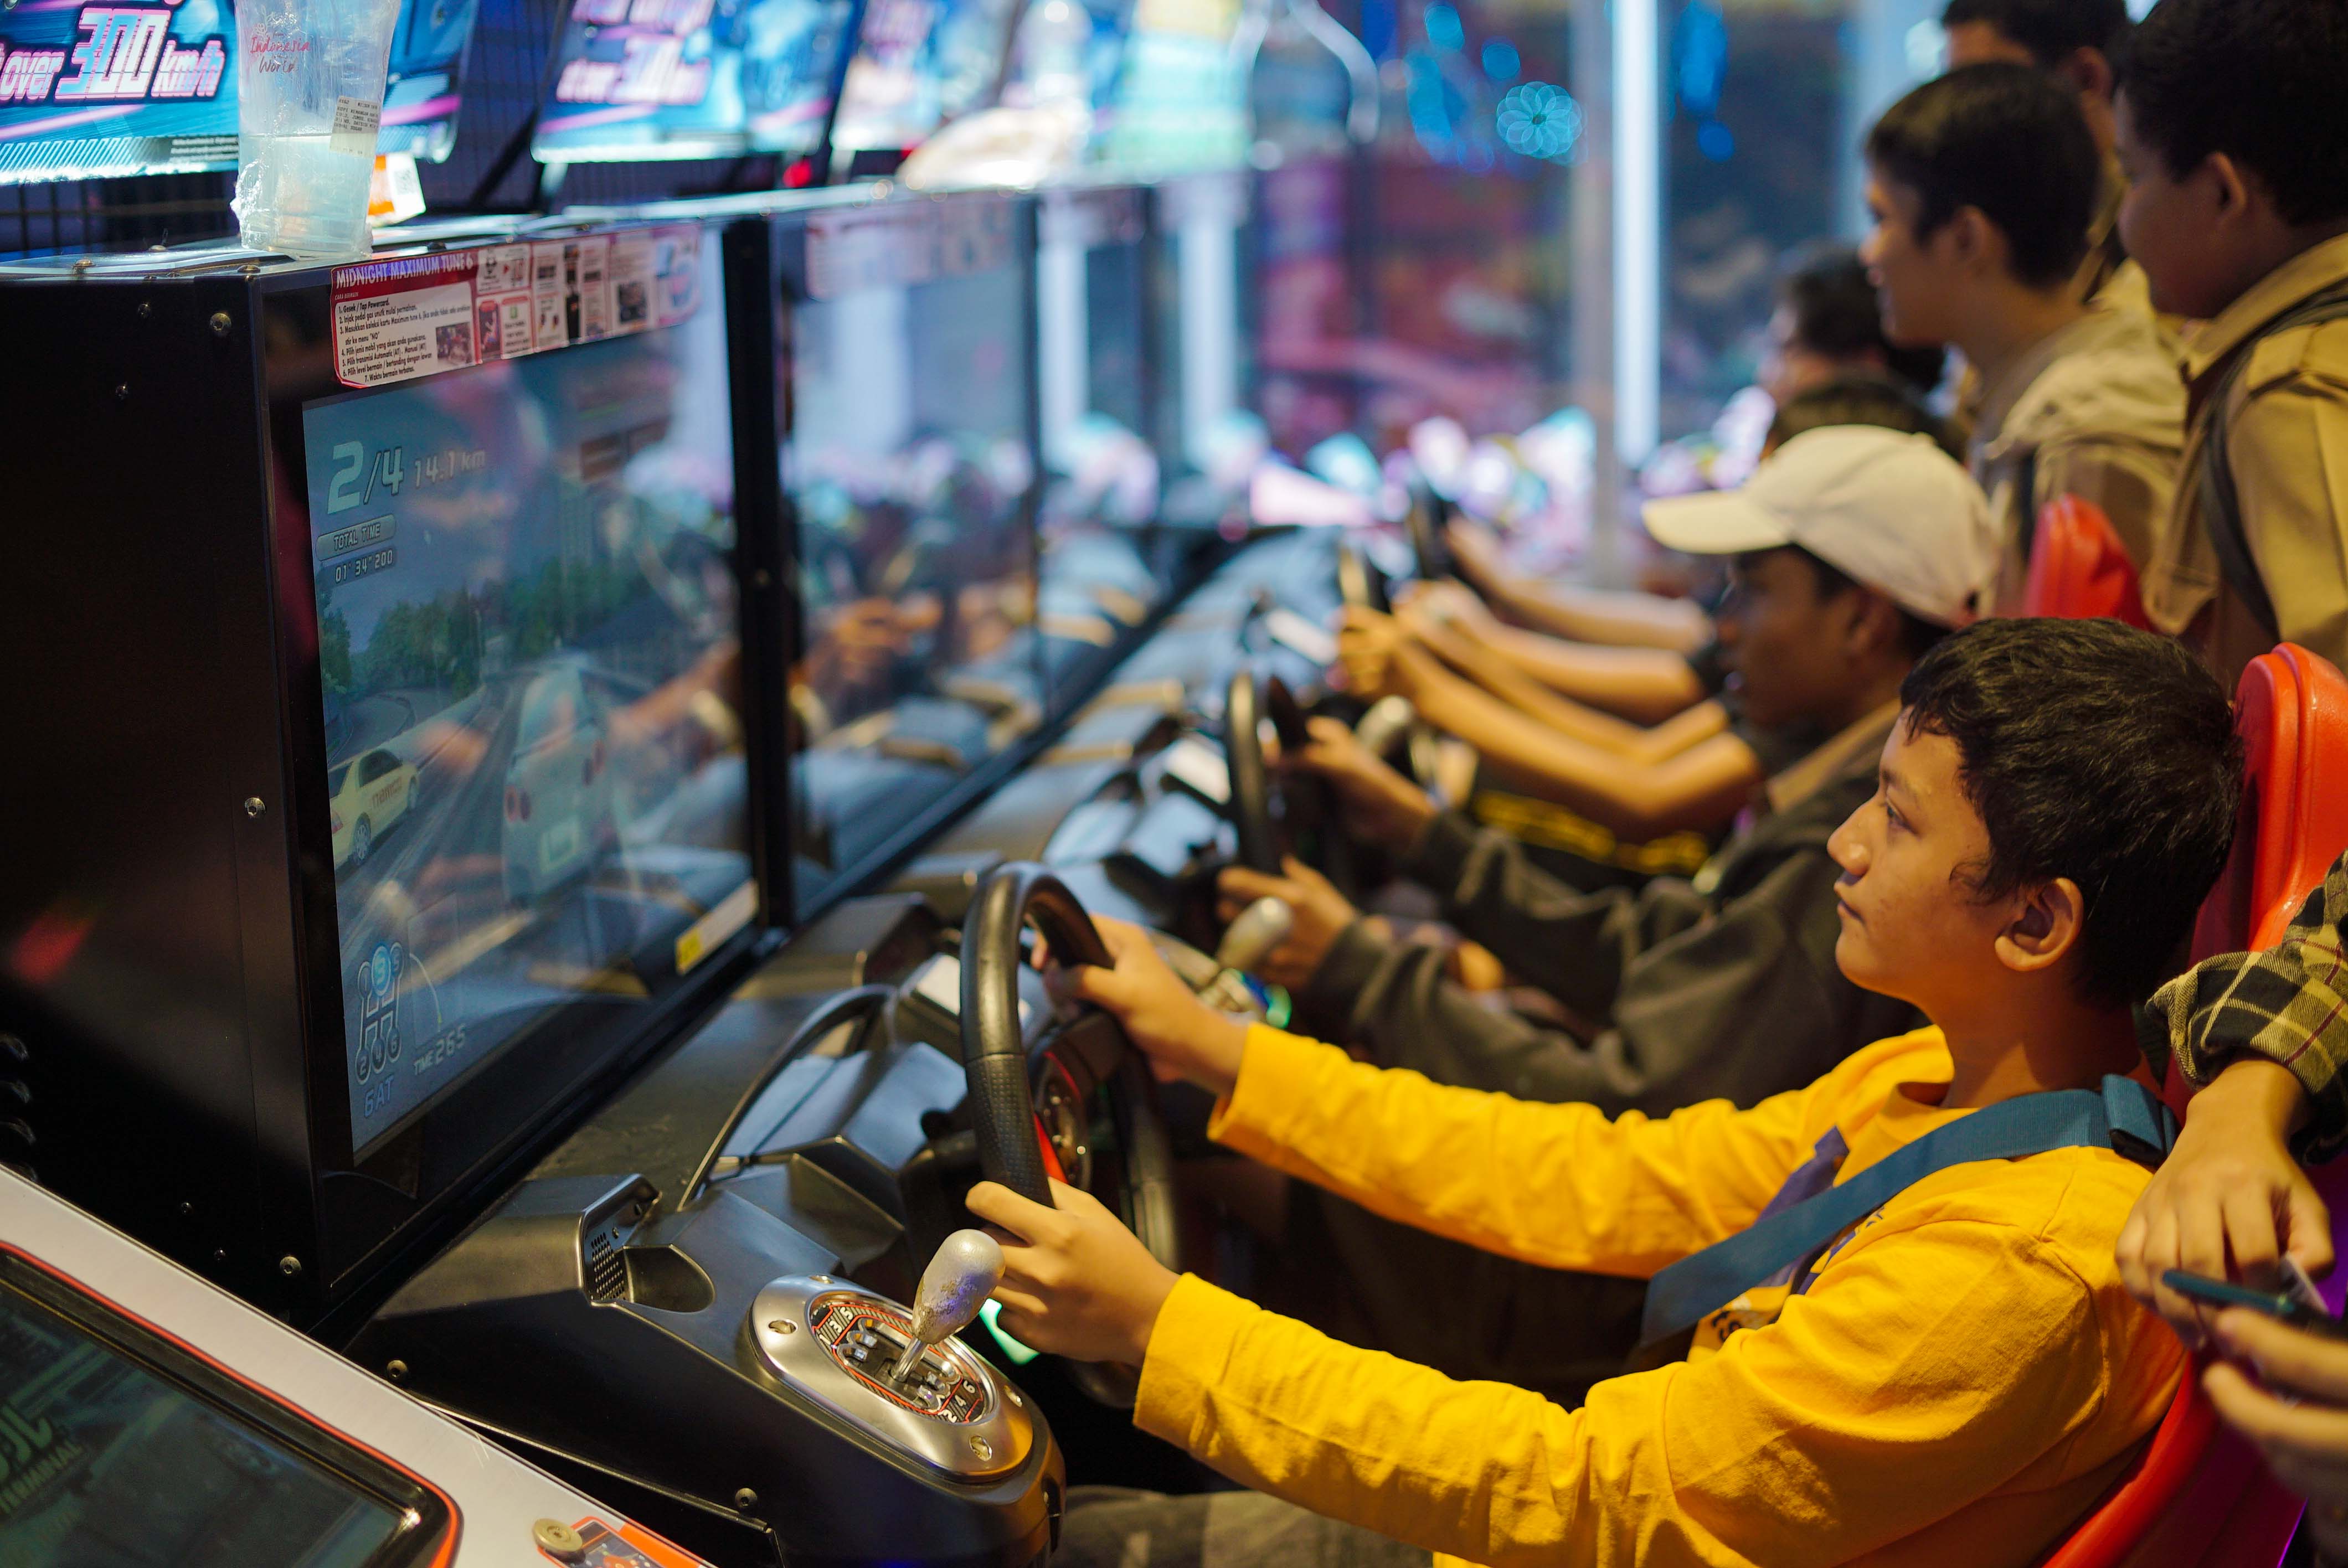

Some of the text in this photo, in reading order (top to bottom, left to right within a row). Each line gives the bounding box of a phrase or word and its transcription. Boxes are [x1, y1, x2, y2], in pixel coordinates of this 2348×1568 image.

[0, 50, 65, 101] over
[55, 8, 171, 100] 300
[250, 36, 311, 53] Indonesia
[336, 252, 473, 289] MIDNIGHT MAXIMUM TUNE 6
[343, 303, 356, 313] Gesek
[354, 310, 365, 323] pedal
[346, 347, 354, 355] Pilih
[365, 342, 375, 352] mobil
[377, 343, 386, 352] yang
[357, 364, 366, 374] level
[367, 362, 383, 372] bermain
[369, 372, 382, 381] Waktu
[328, 441, 486, 514] 2/4 14.1 km
[333, 523, 380, 551] TOTAL TIME
[359, 1058, 367, 1075] 2
[391, 1034, 398, 1051] 6
[414, 1024, 466, 1075] TIME 265
[829, 1321, 842, 1333] 3
[840, 1307, 853, 1320] 5
[943, 1380, 975, 1423] 2 4 6
